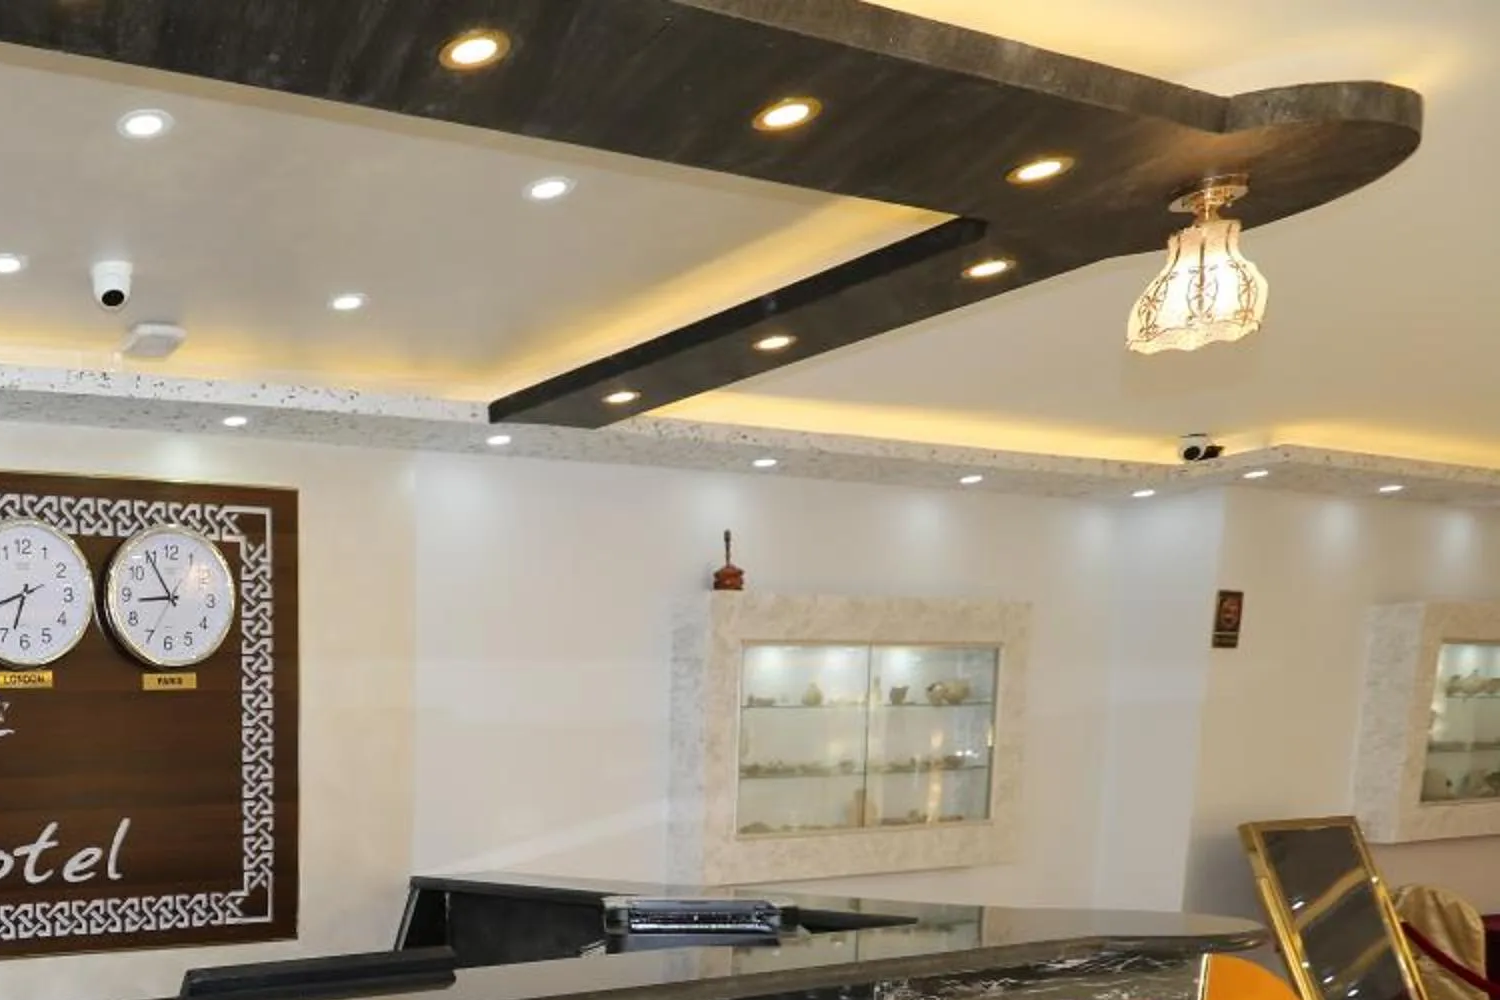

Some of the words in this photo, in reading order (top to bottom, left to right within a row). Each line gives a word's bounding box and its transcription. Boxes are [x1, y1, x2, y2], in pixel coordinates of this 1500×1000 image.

[14, 539, 32, 554] 12
[42, 547, 48, 560] 1
[164, 545, 179, 560] 12
[188, 553, 193, 566] 1
[56, 562, 67, 578] 2
[130, 565, 144, 581] 10
[63, 588, 74, 602] 3
[122, 588, 132, 602] 9
[205, 594, 216, 608] 3
[57, 612, 67, 626] 4
[128, 611, 138, 626] 8
[200, 616, 207, 630] 4
[0, 628, 9, 642] 7
[20, 634, 30, 649] 6
[41, 628, 52, 643] 5
[145, 629, 155, 644] 7
[184, 632, 193, 646] 5
[164, 636, 173, 650] 6
